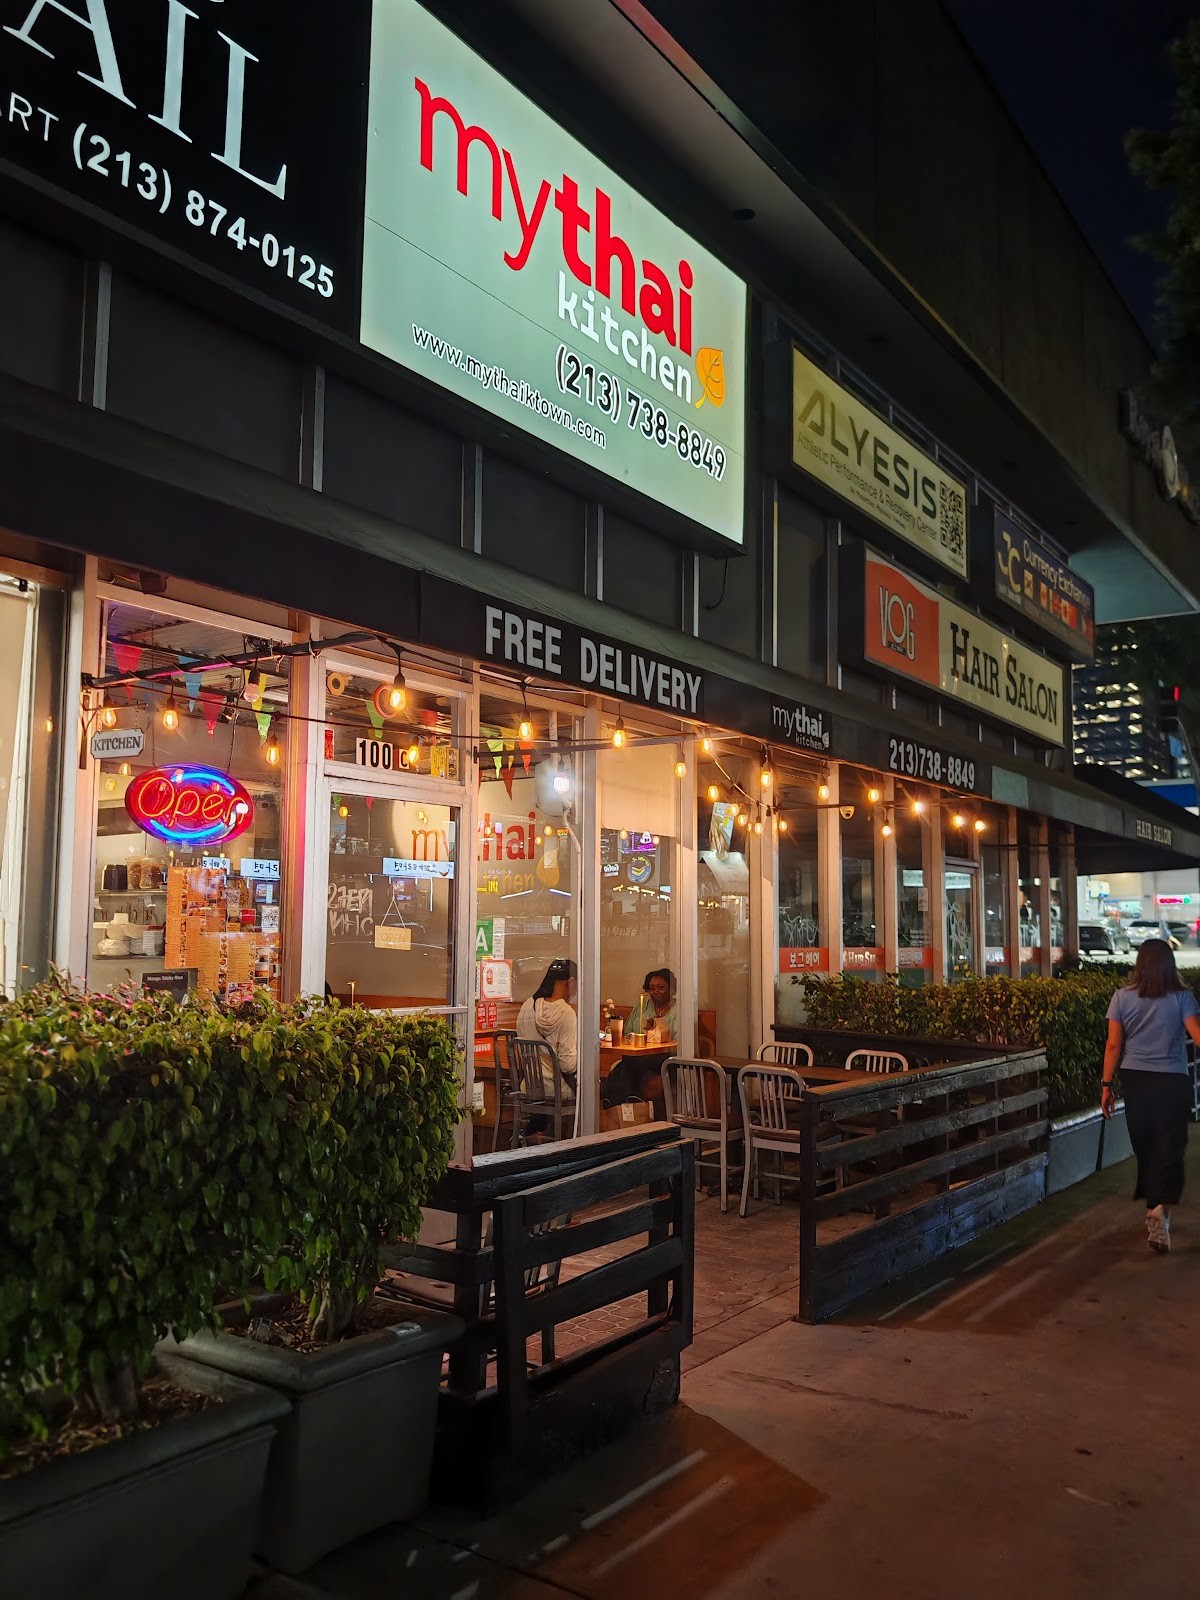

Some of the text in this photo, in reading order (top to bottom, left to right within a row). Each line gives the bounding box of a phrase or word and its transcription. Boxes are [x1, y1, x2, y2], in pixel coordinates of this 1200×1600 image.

[0, 91, 335, 298] RT (213) 874-0125
[557, 270, 692, 404] kitchen
[411, 323, 607, 449] www.mythaiktown.com
[555, 344, 727, 482] (213) 738-8849
[798, 389, 937, 520] ALYESIS
[798, 431, 828, 465] Athletic
[830, 454, 878, 500] Performance
[1023, 540, 1058, 589] Currency
[879, 586, 915, 661] VOG
[485, 605, 702, 714] FREE DELIVERY
[94, 735, 142, 752] KITCHEN
[359, 740, 392, 770] 100
[795, 734, 823, 750] kitchen
[138, 776, 247, 828] Open
[380, 932, 406, 942] OPEN
[475, 926, 489, 952] A
